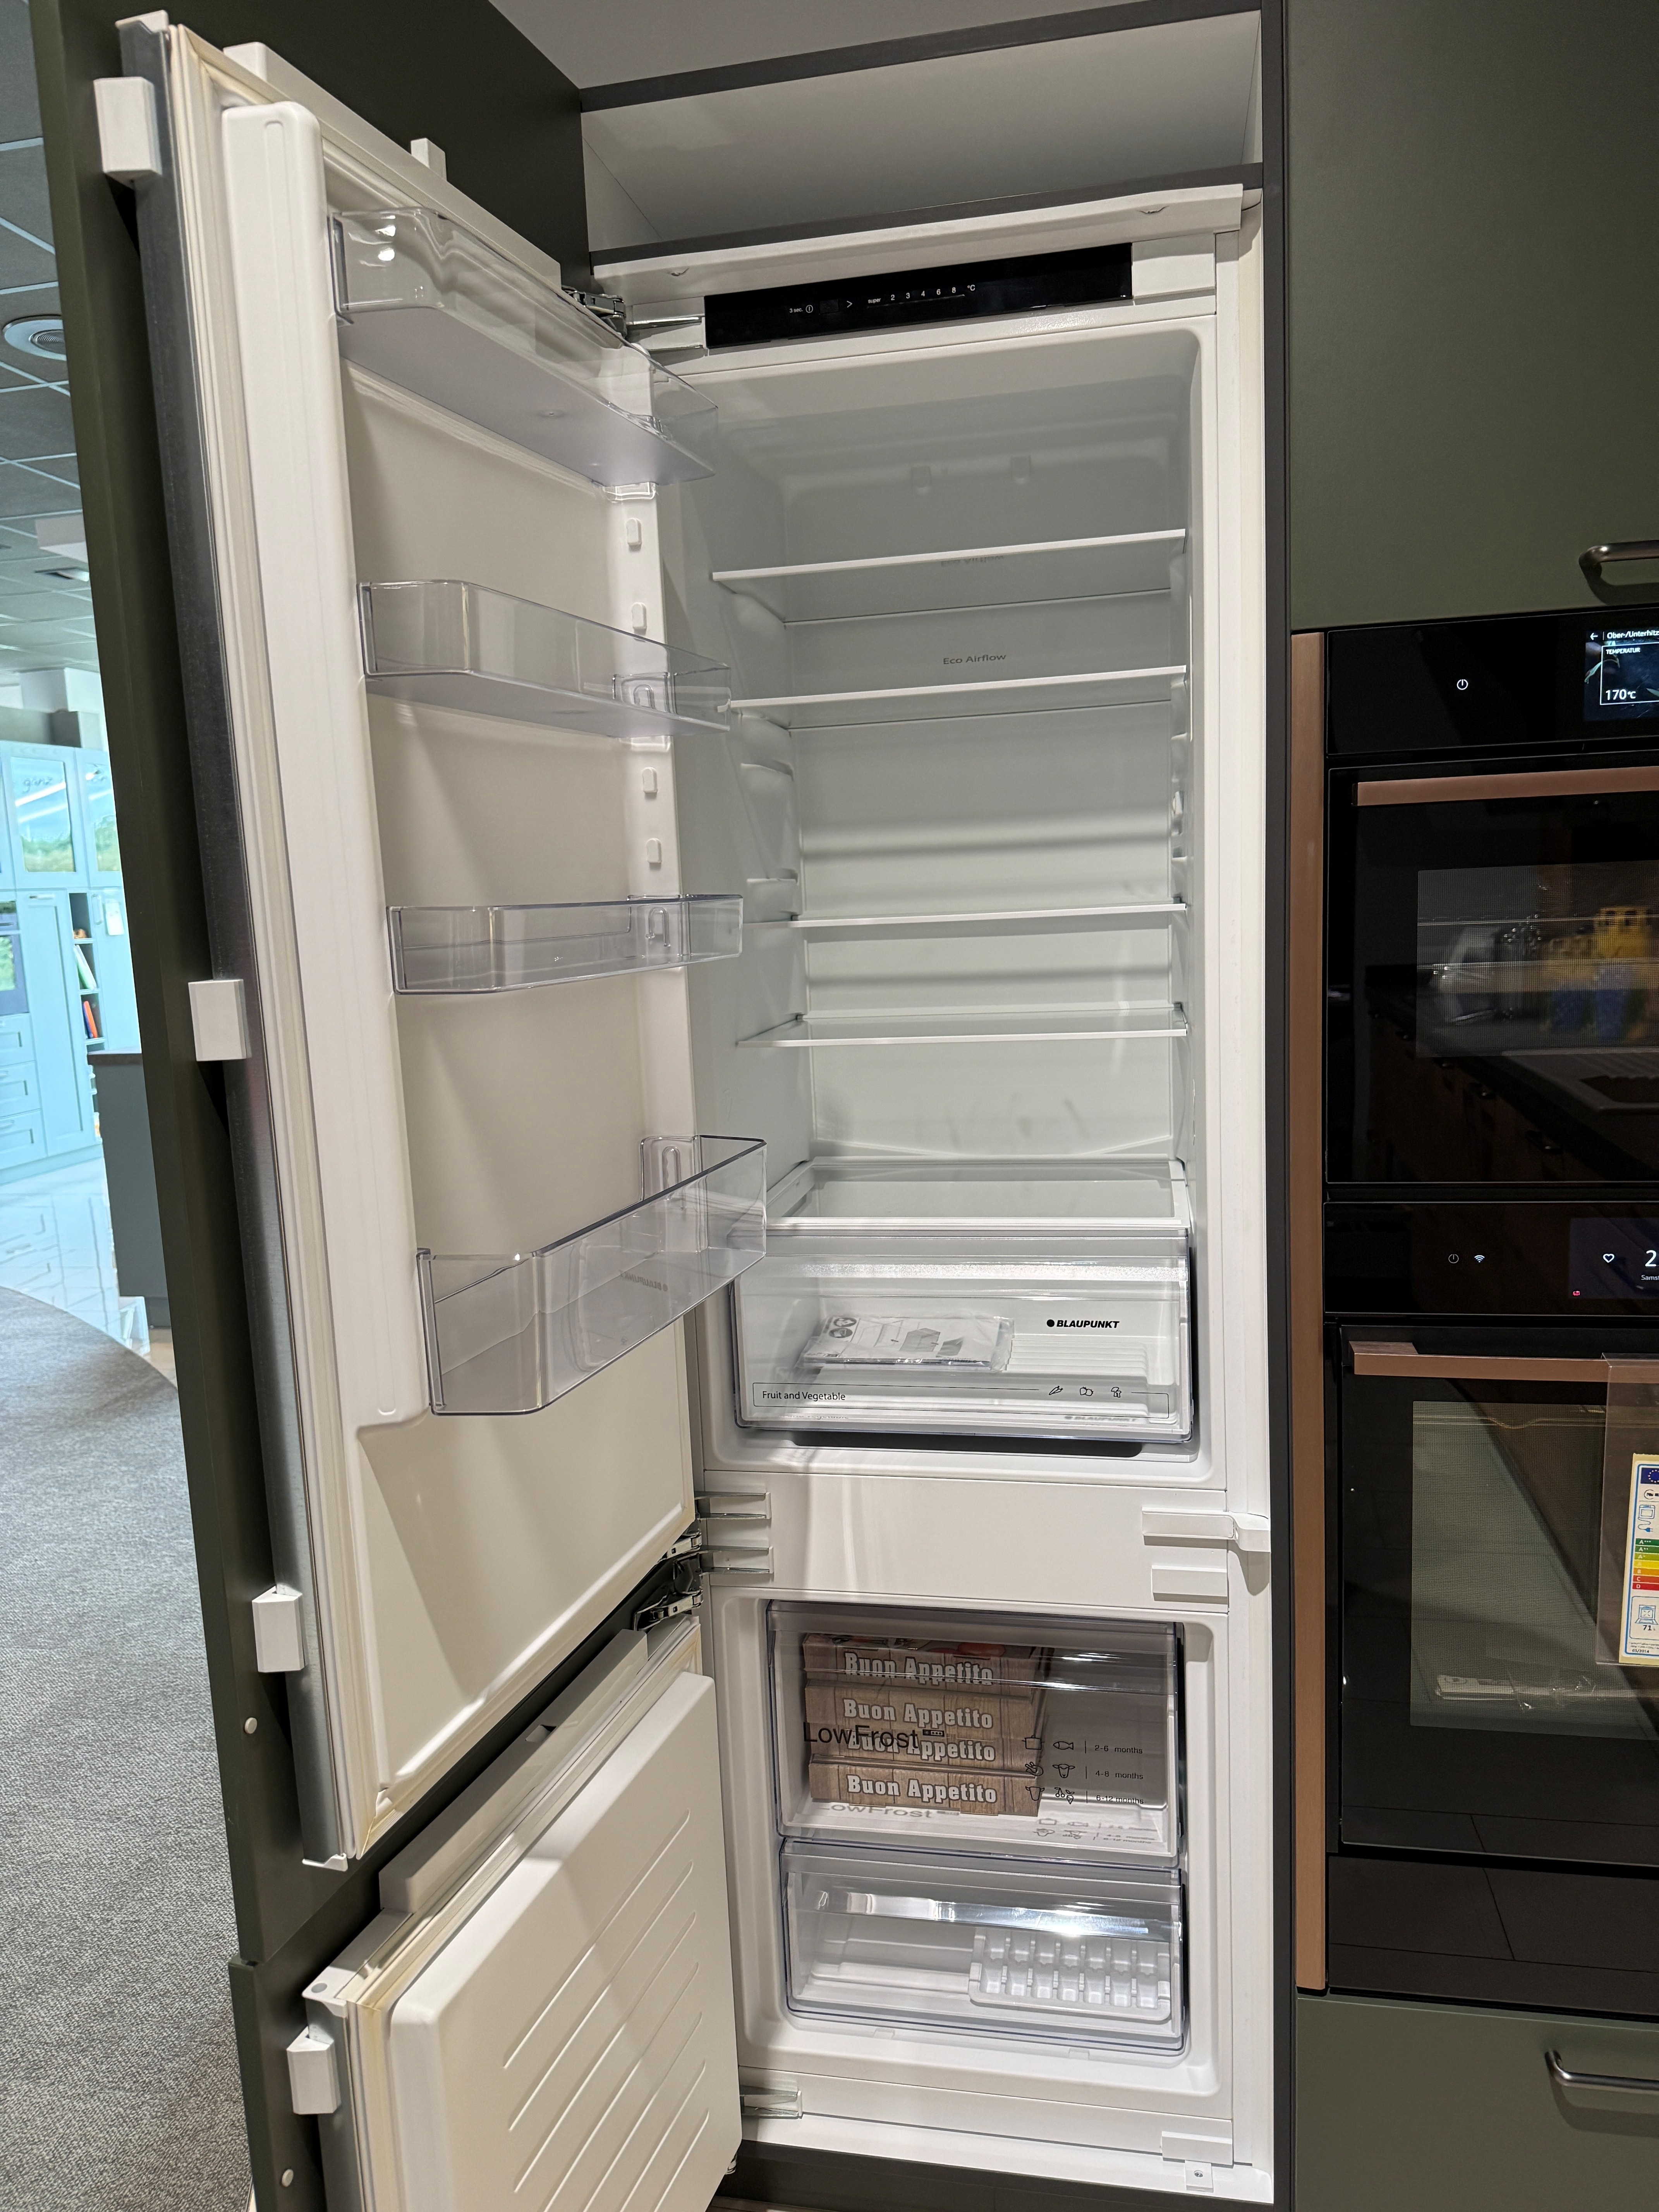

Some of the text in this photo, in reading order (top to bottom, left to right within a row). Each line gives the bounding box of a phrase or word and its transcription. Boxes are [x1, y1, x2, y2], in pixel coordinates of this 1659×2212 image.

[965, 654, 1006, 663] Airflow
[1645, 1250, 1657, 1267] 2
[1056, 1320, 1120, 1328] BLAUPUNKT
[784, 1391, 800, 1399] and
[802, 1392, 845, 1401] Vegetable
[844, 1652, 994, 1685] Buon Appetito
[843, 1698, 994, 1729] Buon Appetito
[803, 1722, 918, 1749] LowFrost
[907, 1735, 996, 1762] Appetito
[847, 1774, 998, 1804] Buon Appetito
[1116, 1796, 1144, 1805] months
